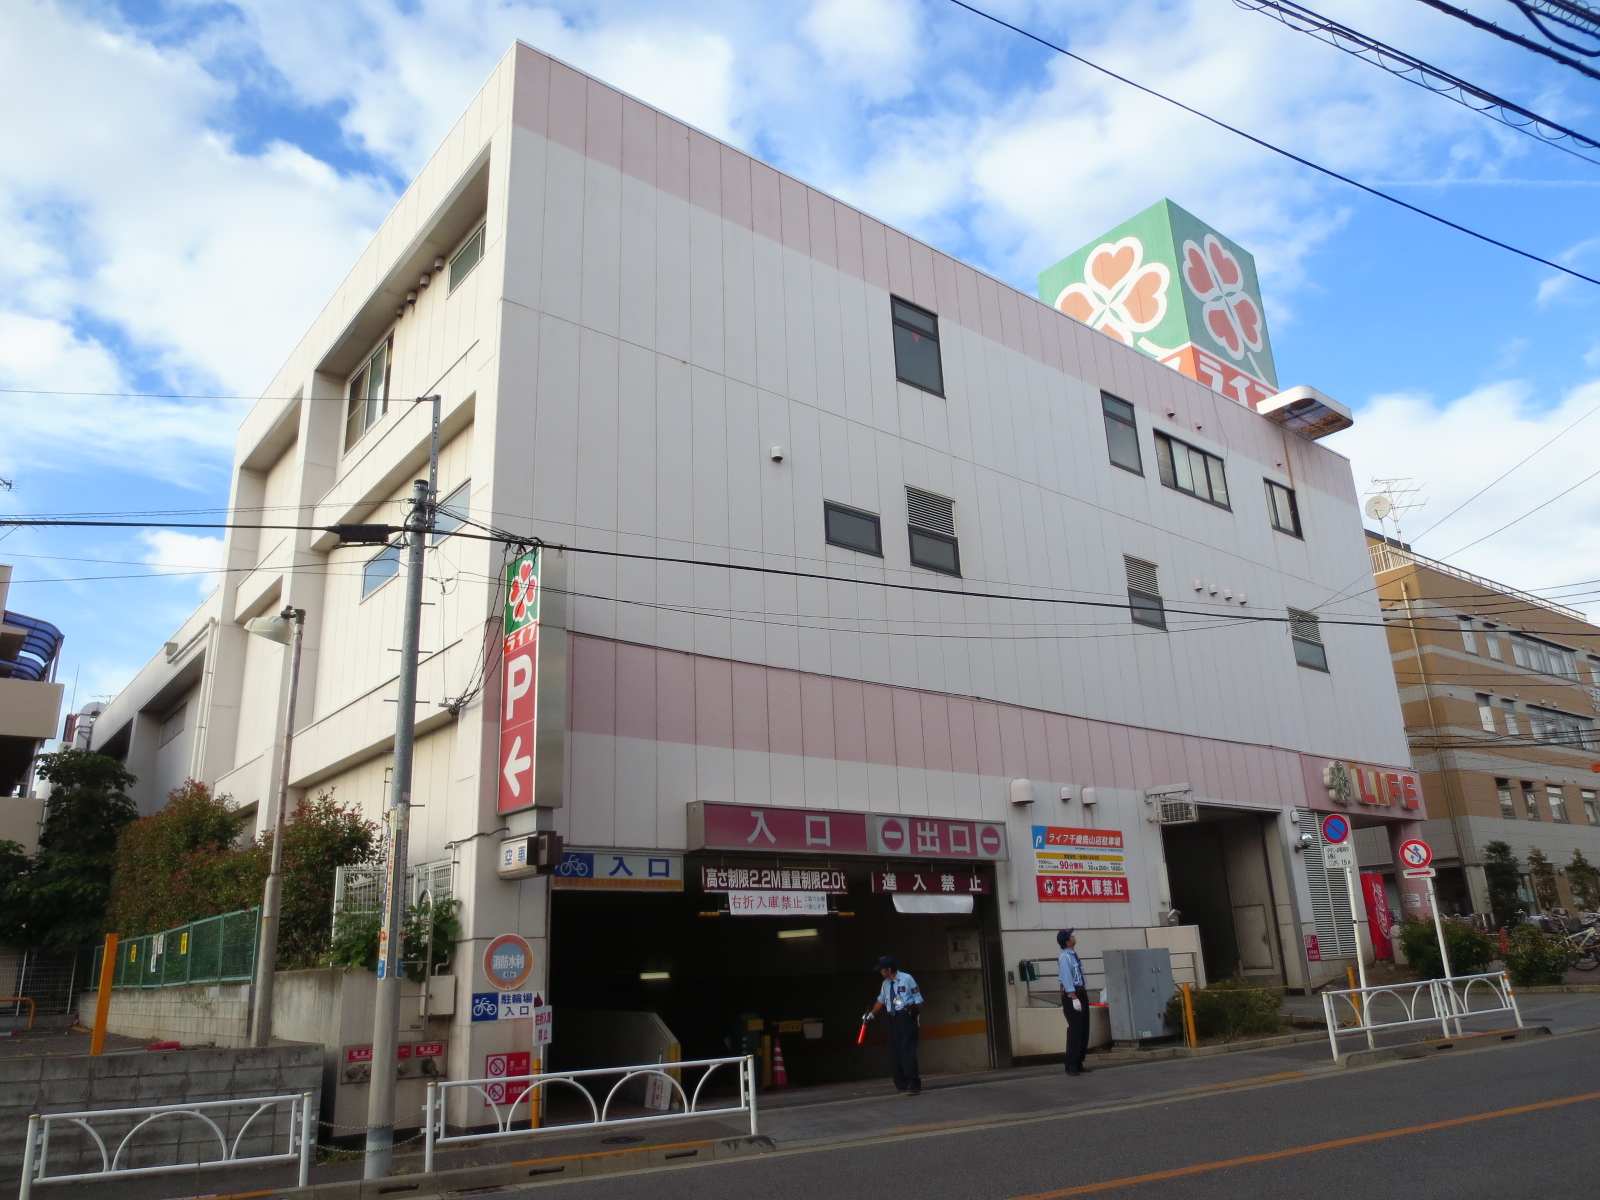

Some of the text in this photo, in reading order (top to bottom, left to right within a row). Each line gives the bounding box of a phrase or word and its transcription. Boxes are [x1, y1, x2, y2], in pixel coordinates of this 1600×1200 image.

[506, 623, 537, 651] ライフ
[506, 654, 533, 721] P
[1352, 768, 1419, 809] LIFE
[747, 811, 831, 847] 入口
[917, 821, 970, 853] 出口
[504, 845, 526, 866] 空車
[608, 857, 669, 877] 入口
[706, 869, 846, 890] 高さ制限2.2M重量制限2.0t
[882, 873, 983, 892] 進入禁止
[1056, 878, 1124, 896] 右折入庫禁止
[731, 895, 803, 910] 右折入庫禁止
[493, 954, 525, 969] 消防水利
[501, 993, 533, 1005] 駐輪場
[505, 1006, 530, 1017] 入口
